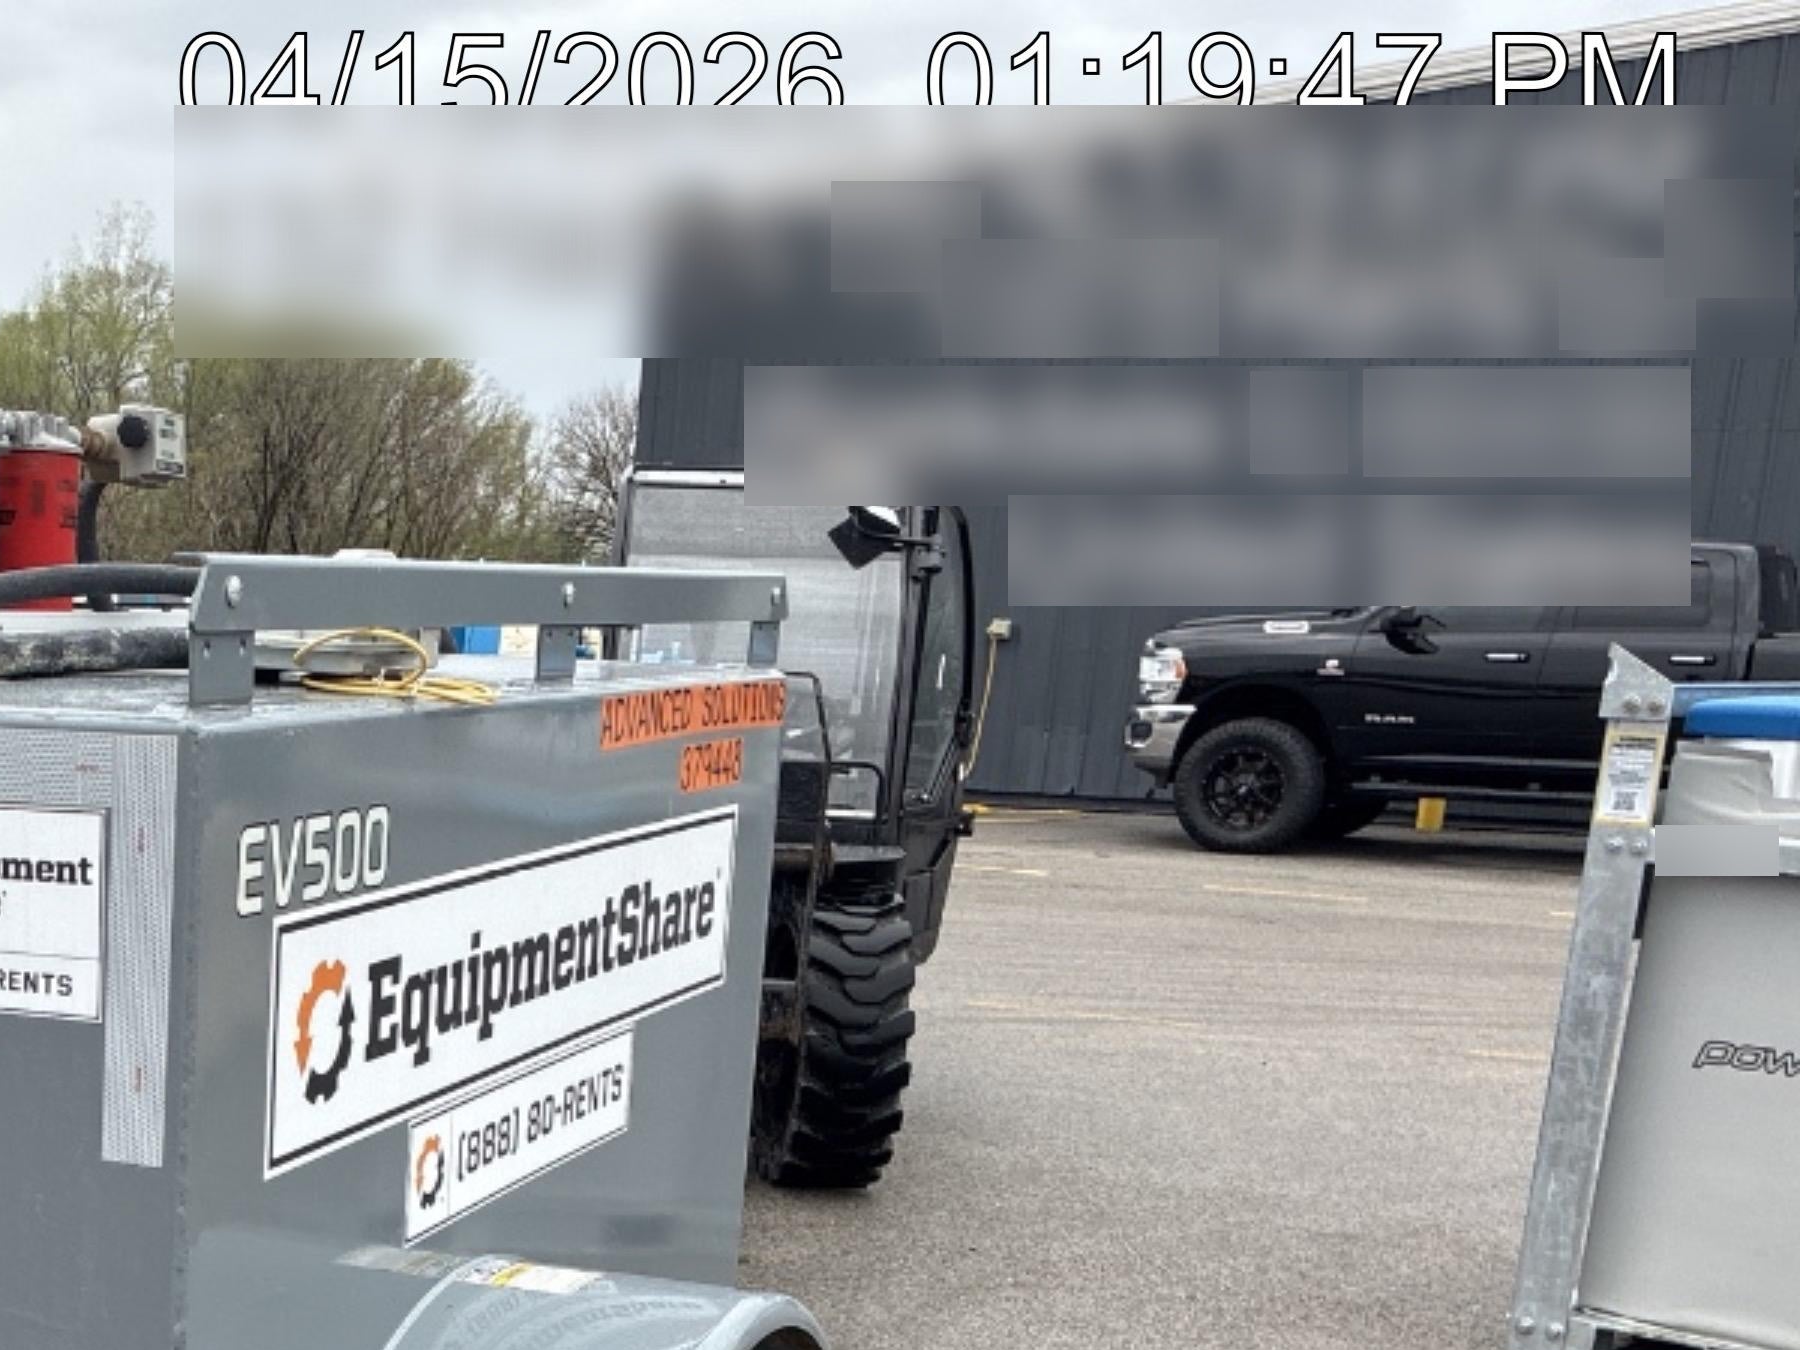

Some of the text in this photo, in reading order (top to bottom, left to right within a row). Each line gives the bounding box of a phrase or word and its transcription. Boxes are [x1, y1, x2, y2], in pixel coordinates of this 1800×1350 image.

[600, 681, 785, 745] ADVANCED SOLUTIONS
[237, 804, 390, 917] EV500
[364, 879, 716, 1067] EquipmentShare
[457, 1063, 624, 1182] (888) 80-RENTS
